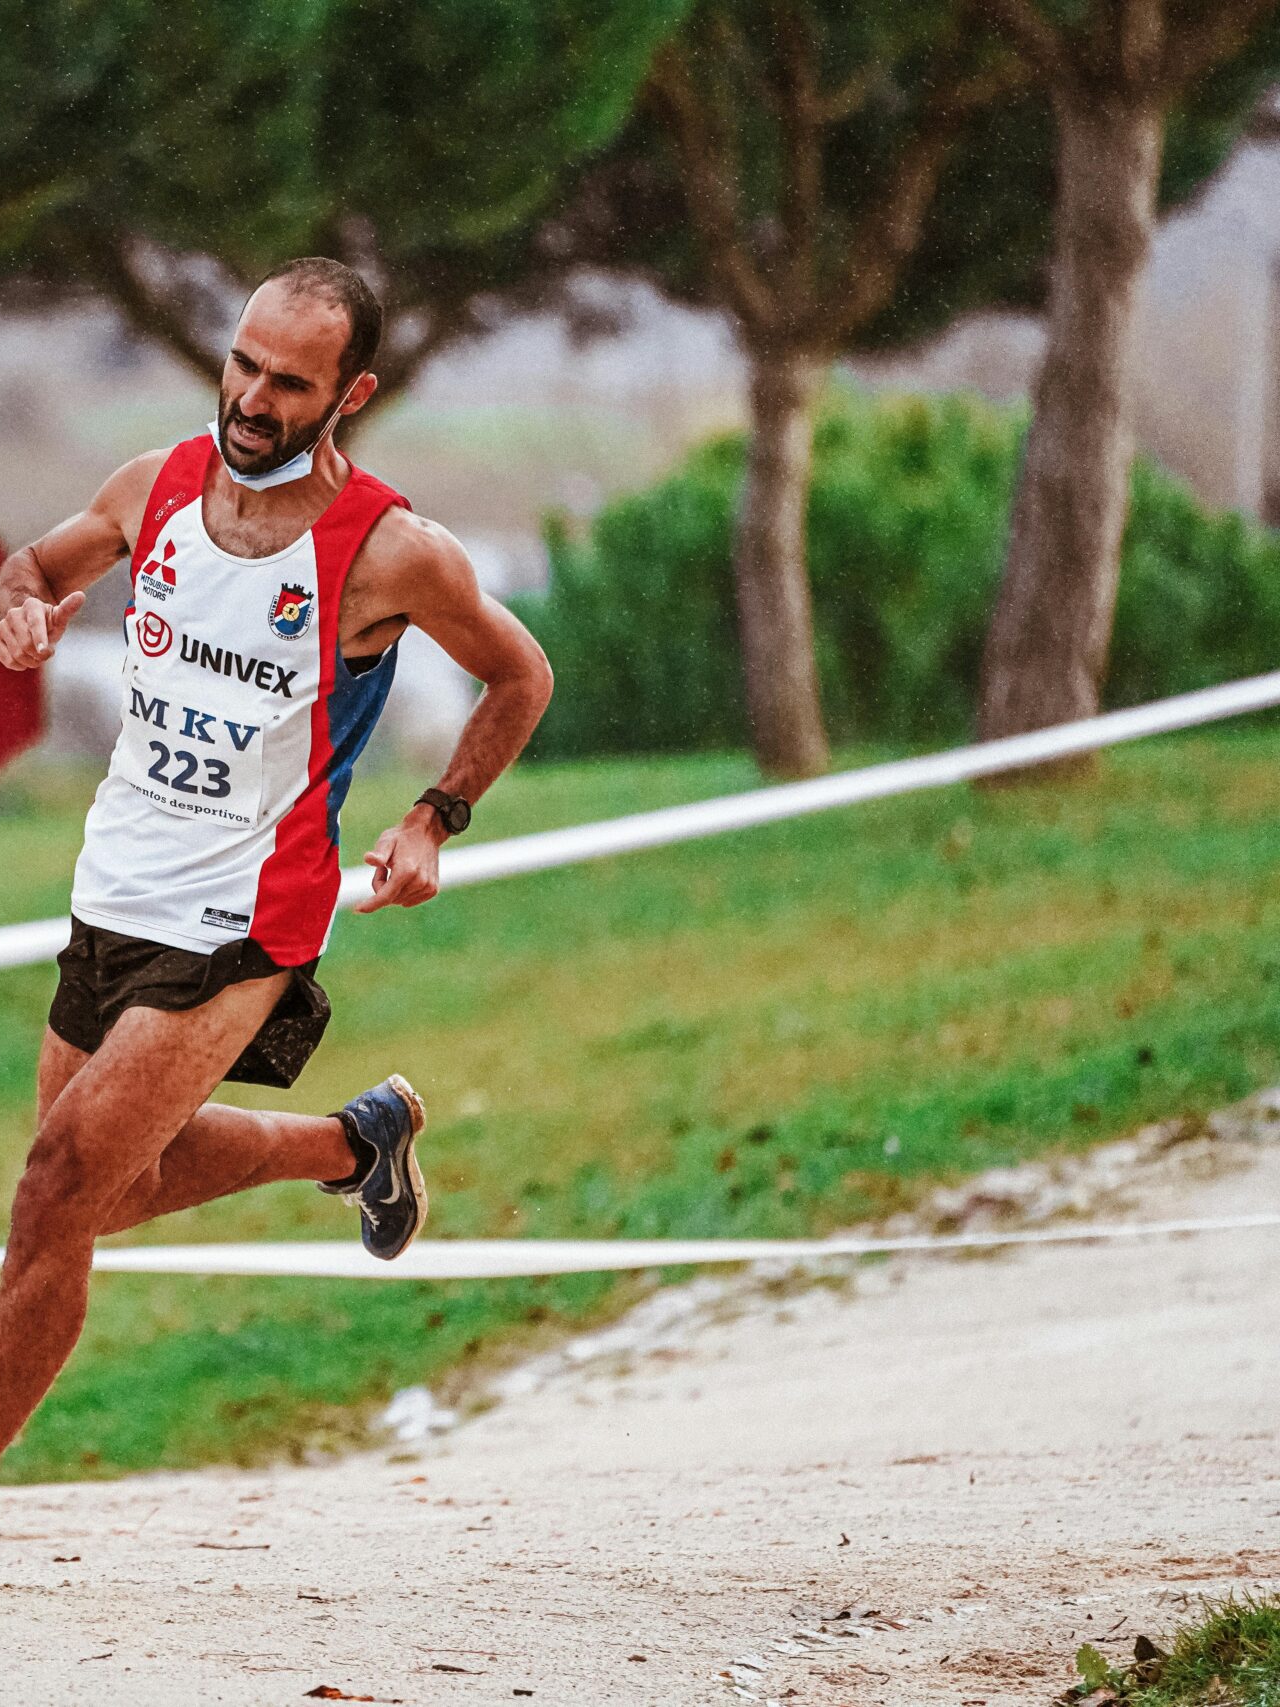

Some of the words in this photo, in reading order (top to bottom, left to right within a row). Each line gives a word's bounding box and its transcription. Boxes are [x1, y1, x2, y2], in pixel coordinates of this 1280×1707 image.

[141, 573, 175, 595] MITSUBISHI
[143, 585, 167, 601] MOTORS
[179, 633, 298, 698] UNIVEX
[147, 740, 231, 799] 223
[129, 782, 167, 803] ventos
[170, 799, 251, 824] desportivos
